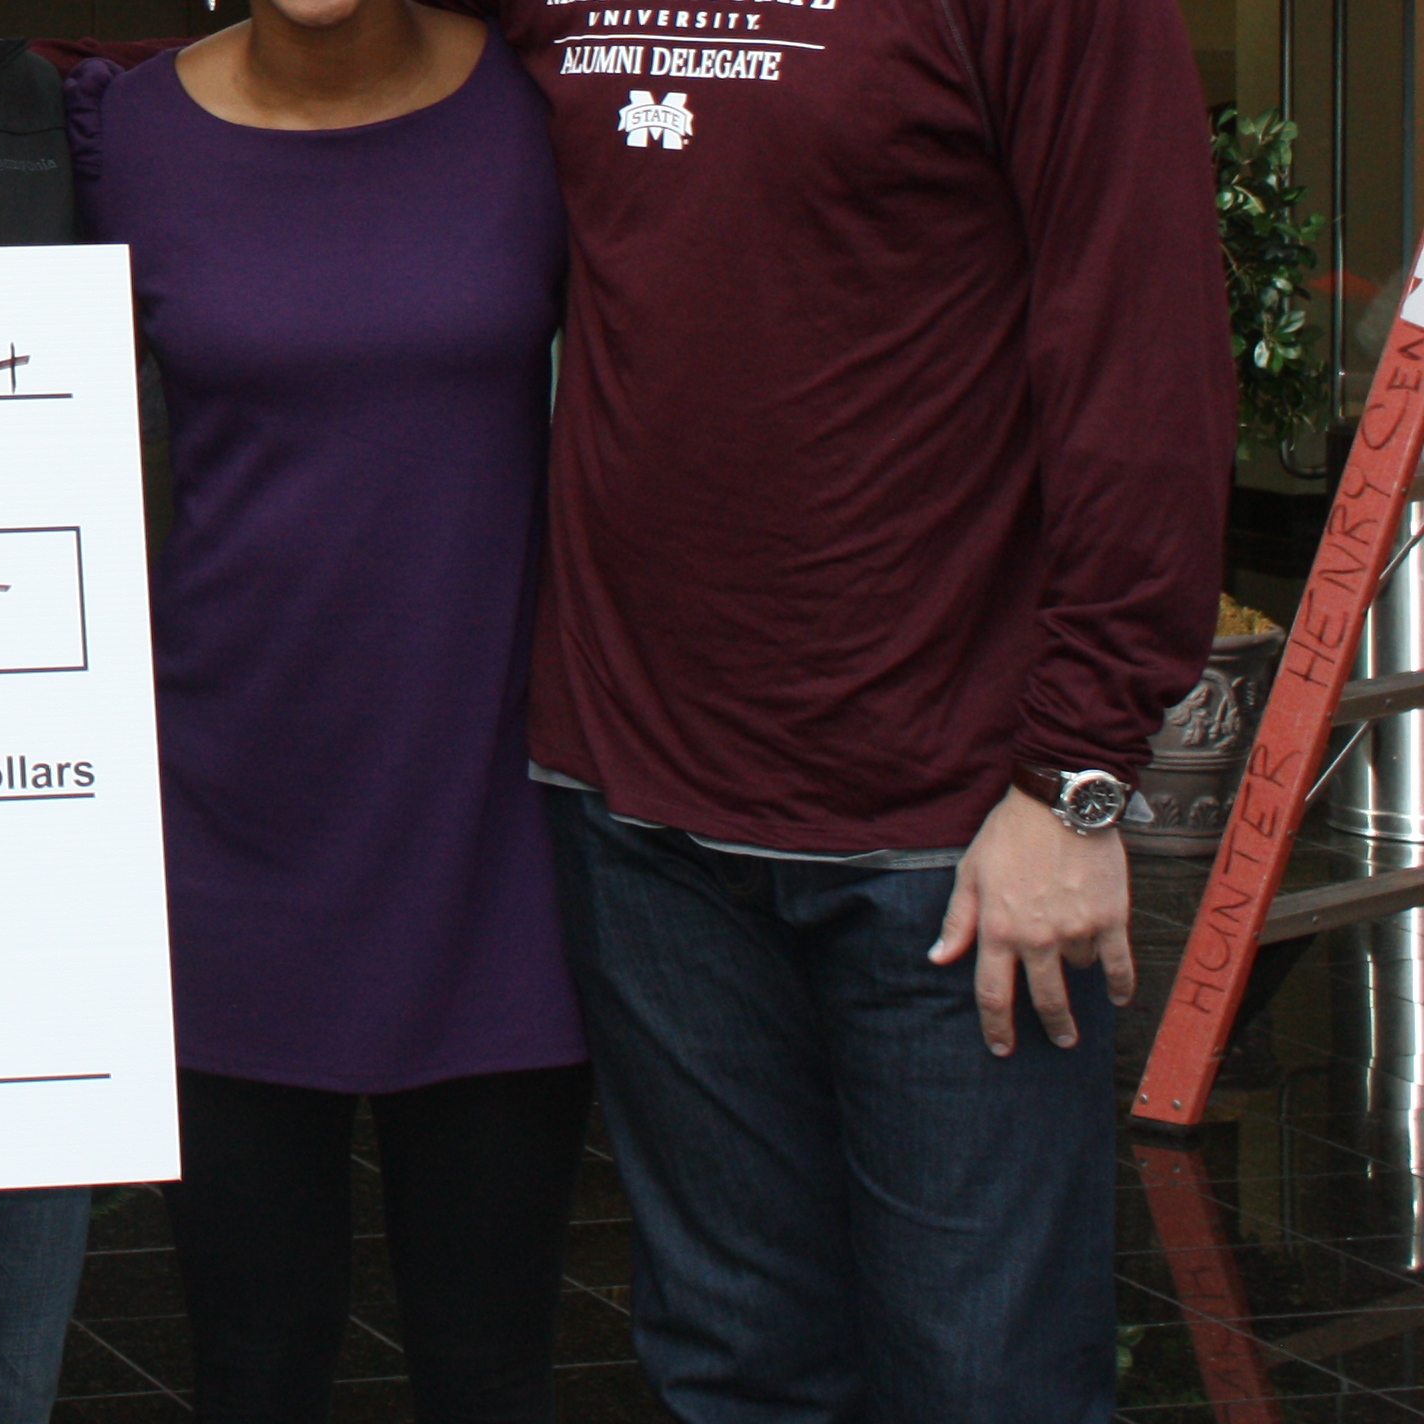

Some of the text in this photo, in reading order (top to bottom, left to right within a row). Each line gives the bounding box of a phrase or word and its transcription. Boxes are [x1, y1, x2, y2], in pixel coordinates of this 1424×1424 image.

[560, 45, 782, 81] ALUMNI DELEGATE
[631, 108, 682, 127] STATE
[1177, 744, 1302, 1014] HUNTER
[1286, 465, 1391, 688] HENRY
